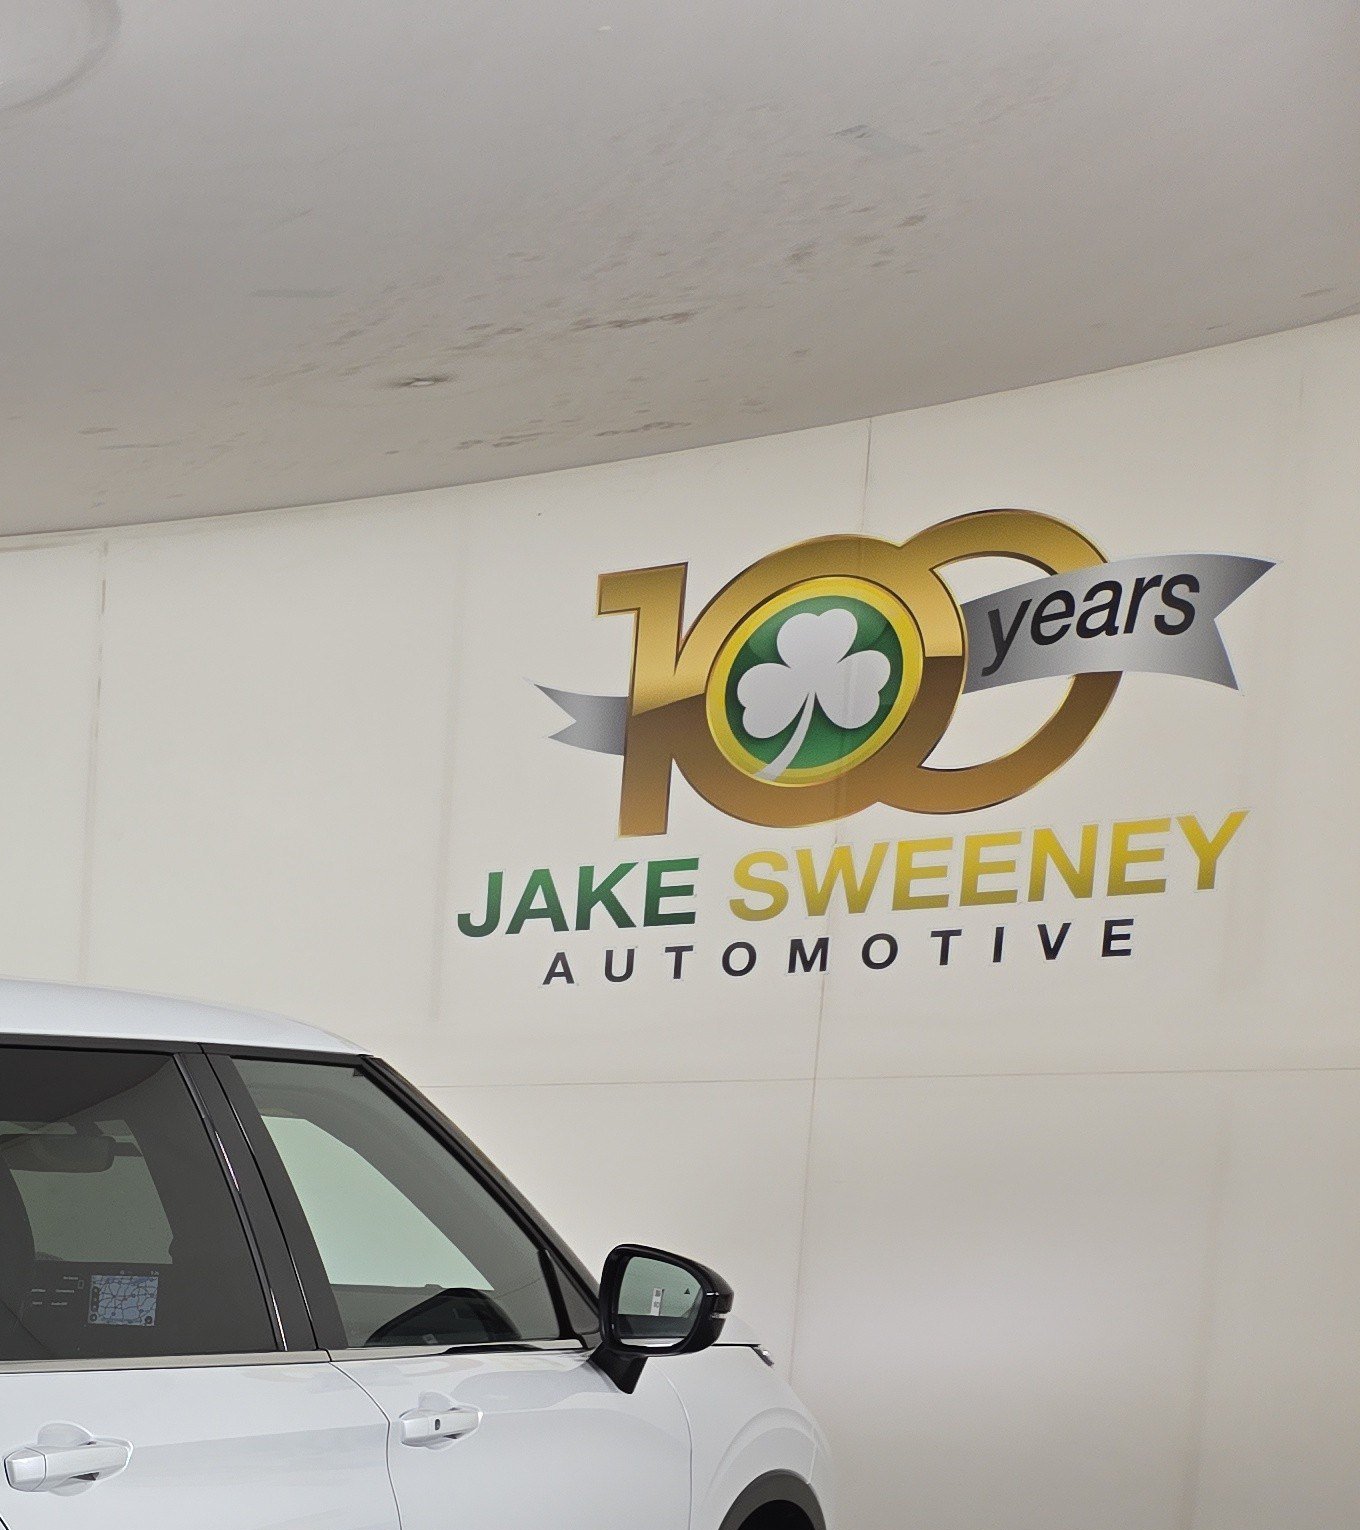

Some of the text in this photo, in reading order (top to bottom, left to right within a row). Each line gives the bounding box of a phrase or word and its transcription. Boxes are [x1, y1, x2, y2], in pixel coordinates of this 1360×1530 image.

[982, 573, 1200, 677] years
[457, 811, 1250, 938] JAKE SWEENEY
[542, 918, 1136, 987] AUTOMOTIVE
